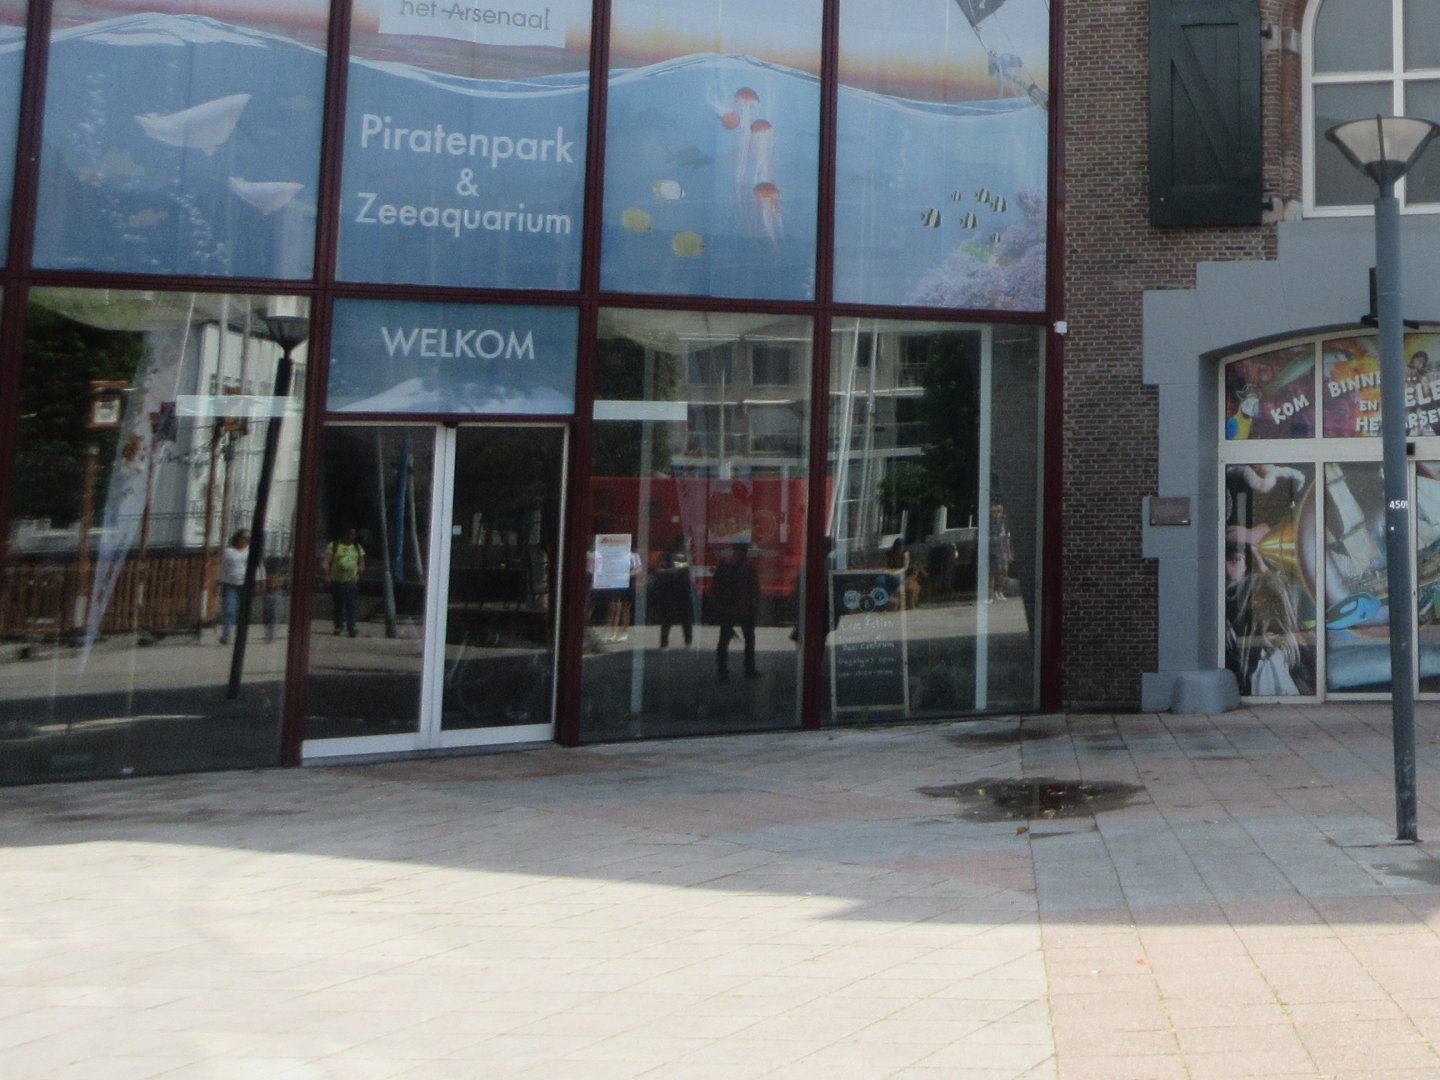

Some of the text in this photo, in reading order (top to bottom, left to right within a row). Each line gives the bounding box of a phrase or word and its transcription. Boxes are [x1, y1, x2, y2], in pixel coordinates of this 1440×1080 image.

[441, 1, 550, 30] Arsenaal
[360, 113, 574, 169] Piratenpark
[456, 168, 480, 198] &
[354, 192, 571, 238] Zeeaquarium
[380, 326, 535, 360] WELKOM
[1270, 394, 1310, 424] KOM
[1359, 400, 1378, 411] EN
[1355, 417, 1381, 432] HE
